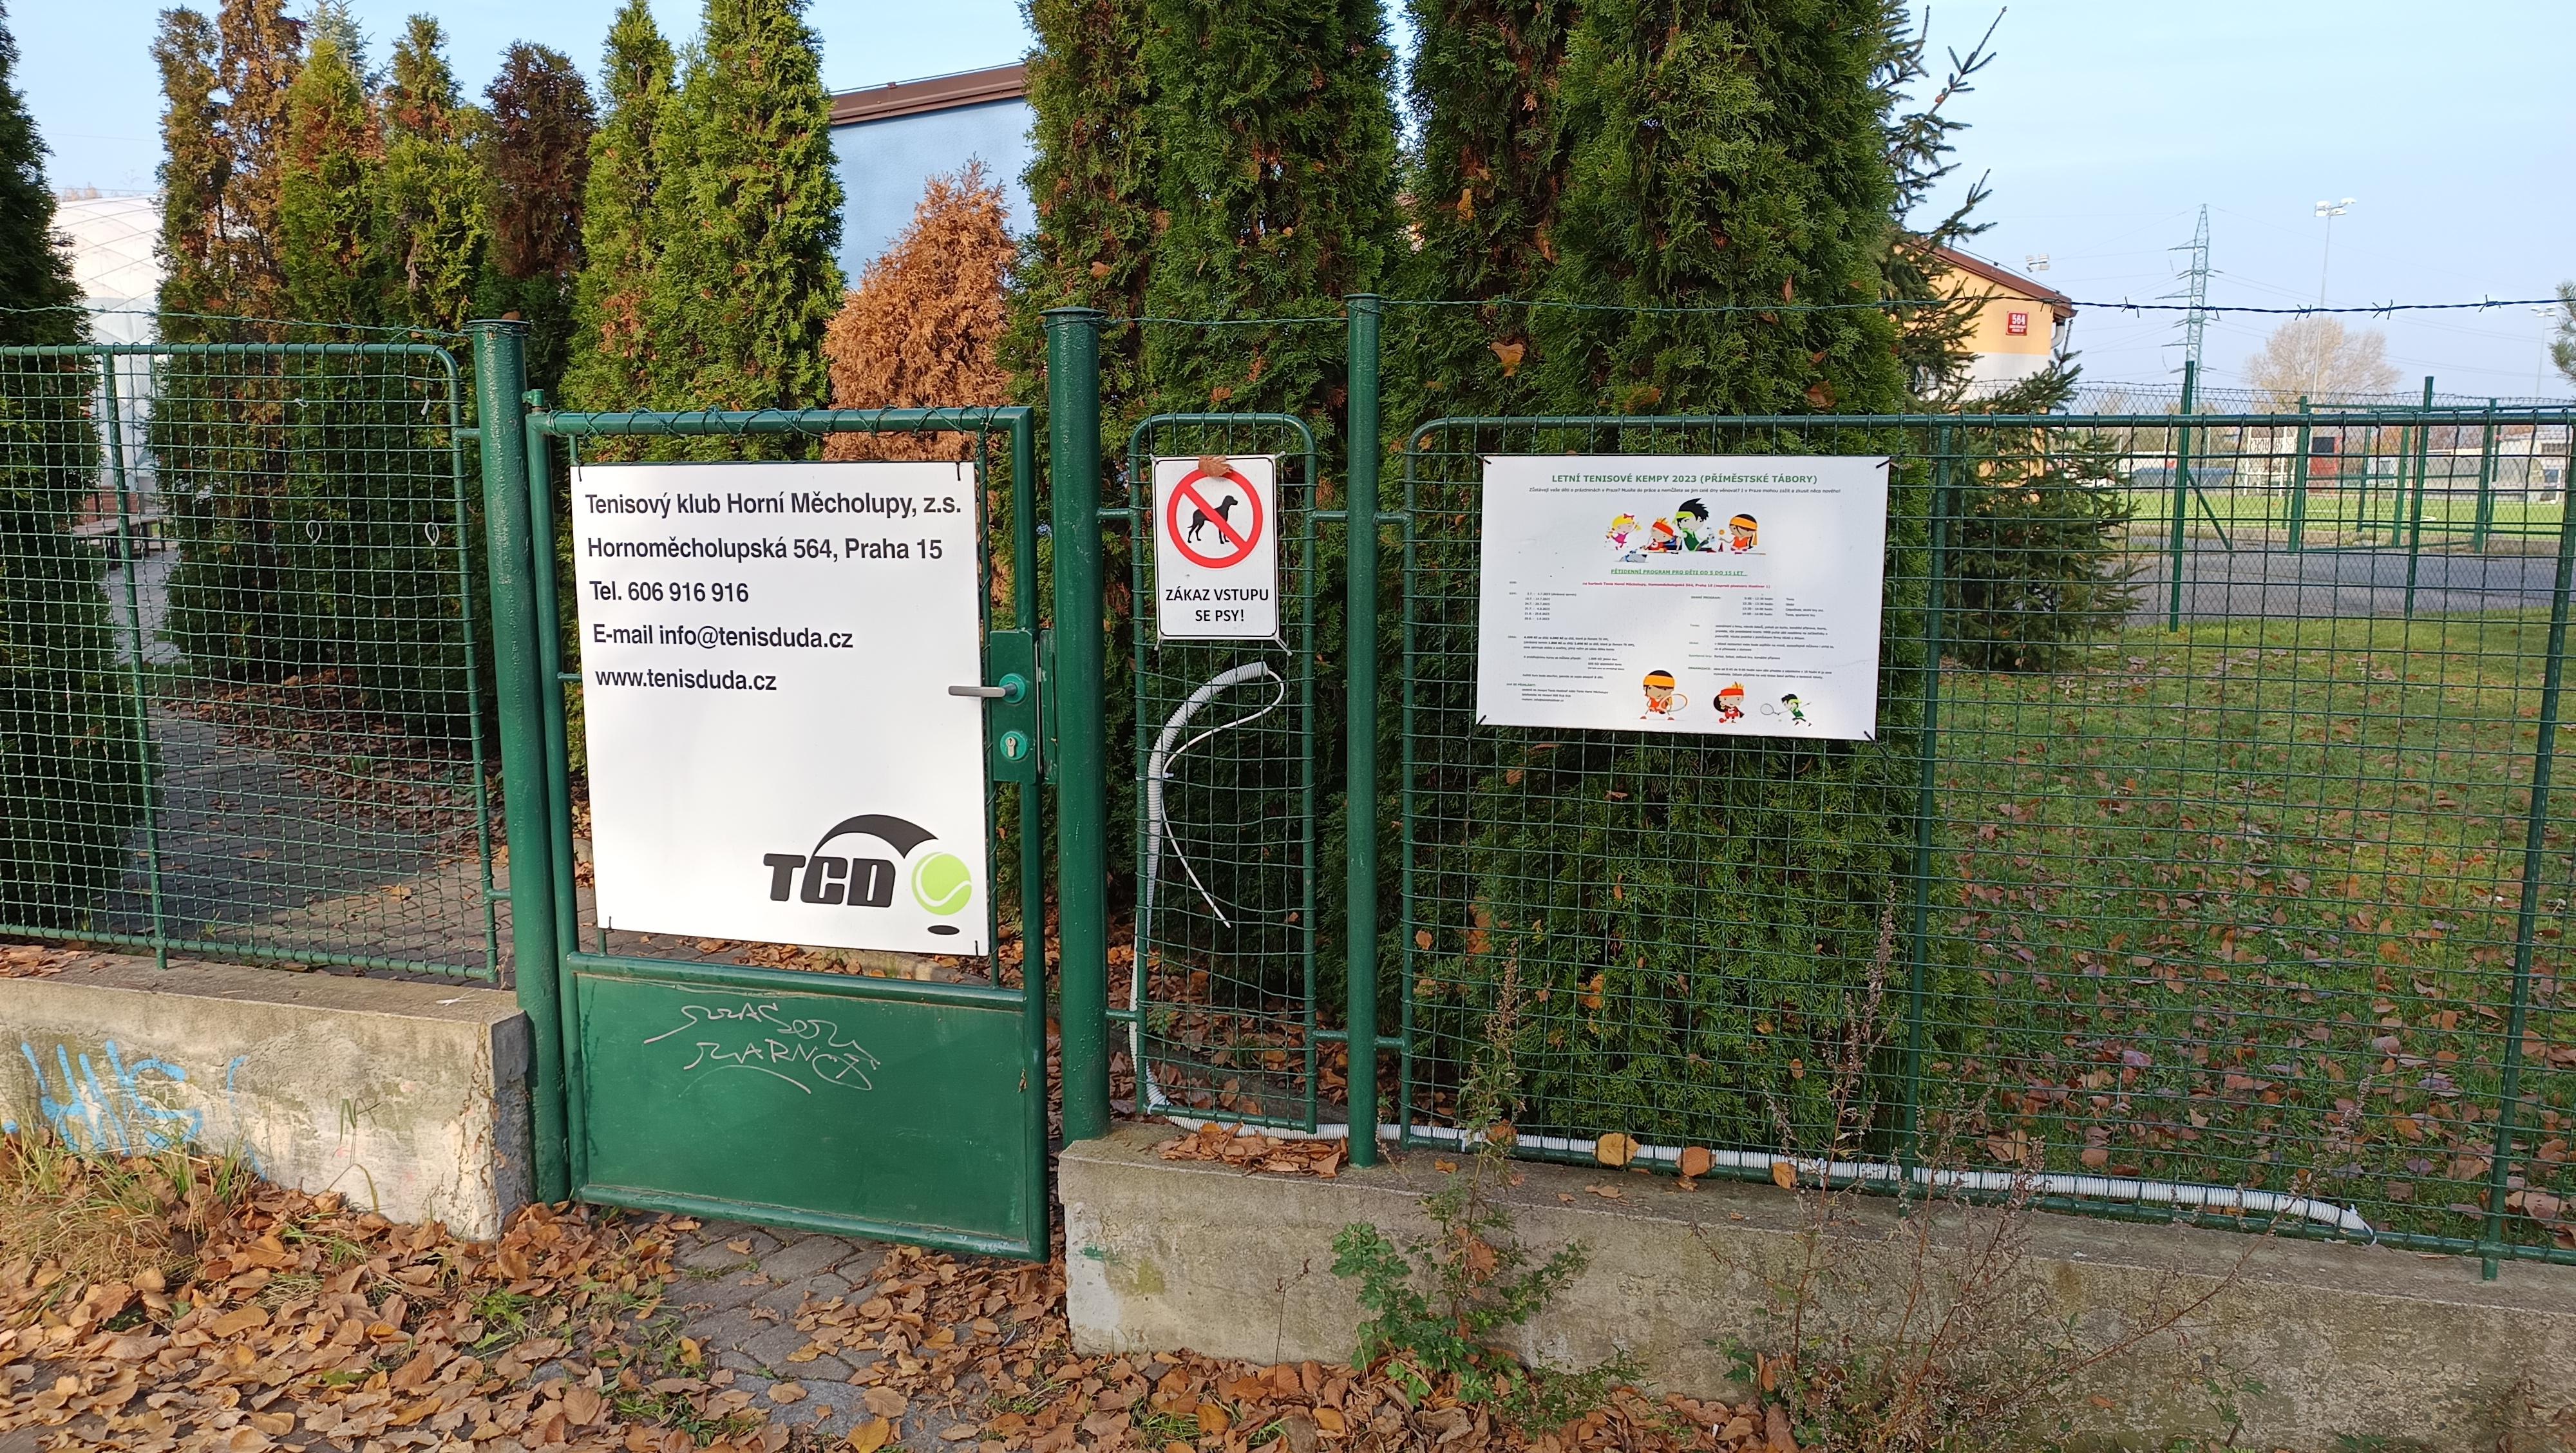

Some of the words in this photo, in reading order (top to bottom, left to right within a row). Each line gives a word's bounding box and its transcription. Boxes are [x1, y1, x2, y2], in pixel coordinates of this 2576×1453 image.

[2012, 314, 2026, 325] 564
[1552, 473, 1580, 482] LETNÍ
[1583, 473, 1633, 482] TENISOVÉ
[1700, 473, 1769, 484] (PŘÍMĚSTSKÉ
[1772, 473, 1817, 484] TÁBORY)
[585, 493, 670, 518] Tenisový
[677, 494, 720, 513] klub
[728, 491, 783, 513] Horní
[791, 491, 916, 518] Měcholupy,
[924, 497, 960, 513] z.s.
[589, 537, 787, 563] Hornoměcholupská
[794, 539, 837, 562] 564,
[846, 538, 909, 558] Praha
[917, 539, 942, 558] 15
[590, 581, 621, 600] Tel.
[629, 582, 663, 601] 606
[670, 583, 705, 602] 916
[712, 583, 748, 602] 916
[1166, 586, 1210, 601] ZÁKAZ
[1213, 588, 1269, 601] VSTUPU
[1195, 609, 1211, 622] SE
[1215, 609, 1245, 622] PSY!
[594, 624, 652, 643] E-mail
[660, 625, 853, 649] info@tenisduda.cz
[596, 669, 776, 690] www.tenisduda.cz
[763, 853, 896, 908] TCD
